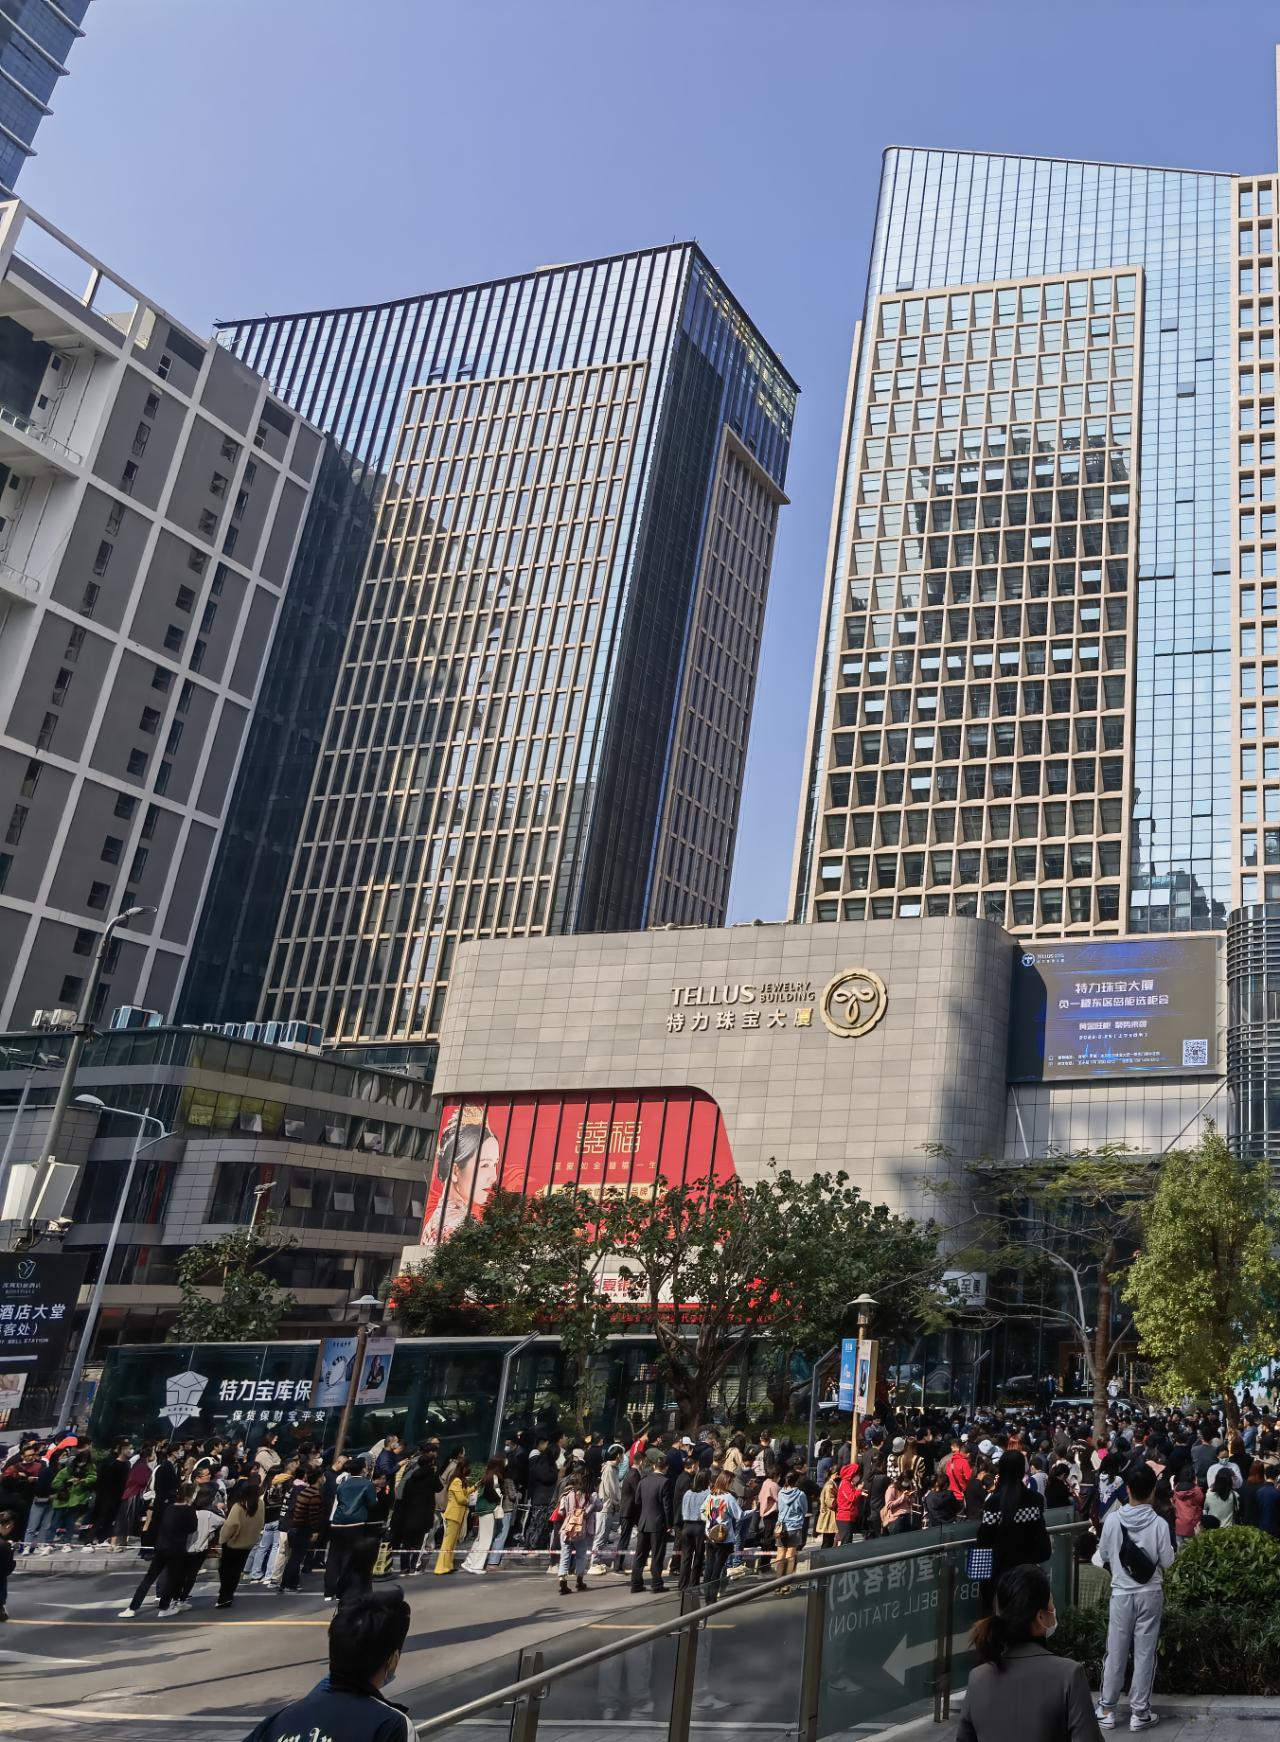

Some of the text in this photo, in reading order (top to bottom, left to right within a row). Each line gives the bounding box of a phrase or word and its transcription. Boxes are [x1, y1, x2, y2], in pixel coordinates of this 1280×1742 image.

[761, 982, 811, 993] JEWELRY
[1075, 979, 1154, 994] 特力珠宝大厦
[672, 984, 755, 1006] TELLUS
[760, 992, 816, 1003] BUILDING
[666, 1007, 813, 1032] 特力珠宝大厦
[0, 1303, 66, 1320] 酒店大堂
